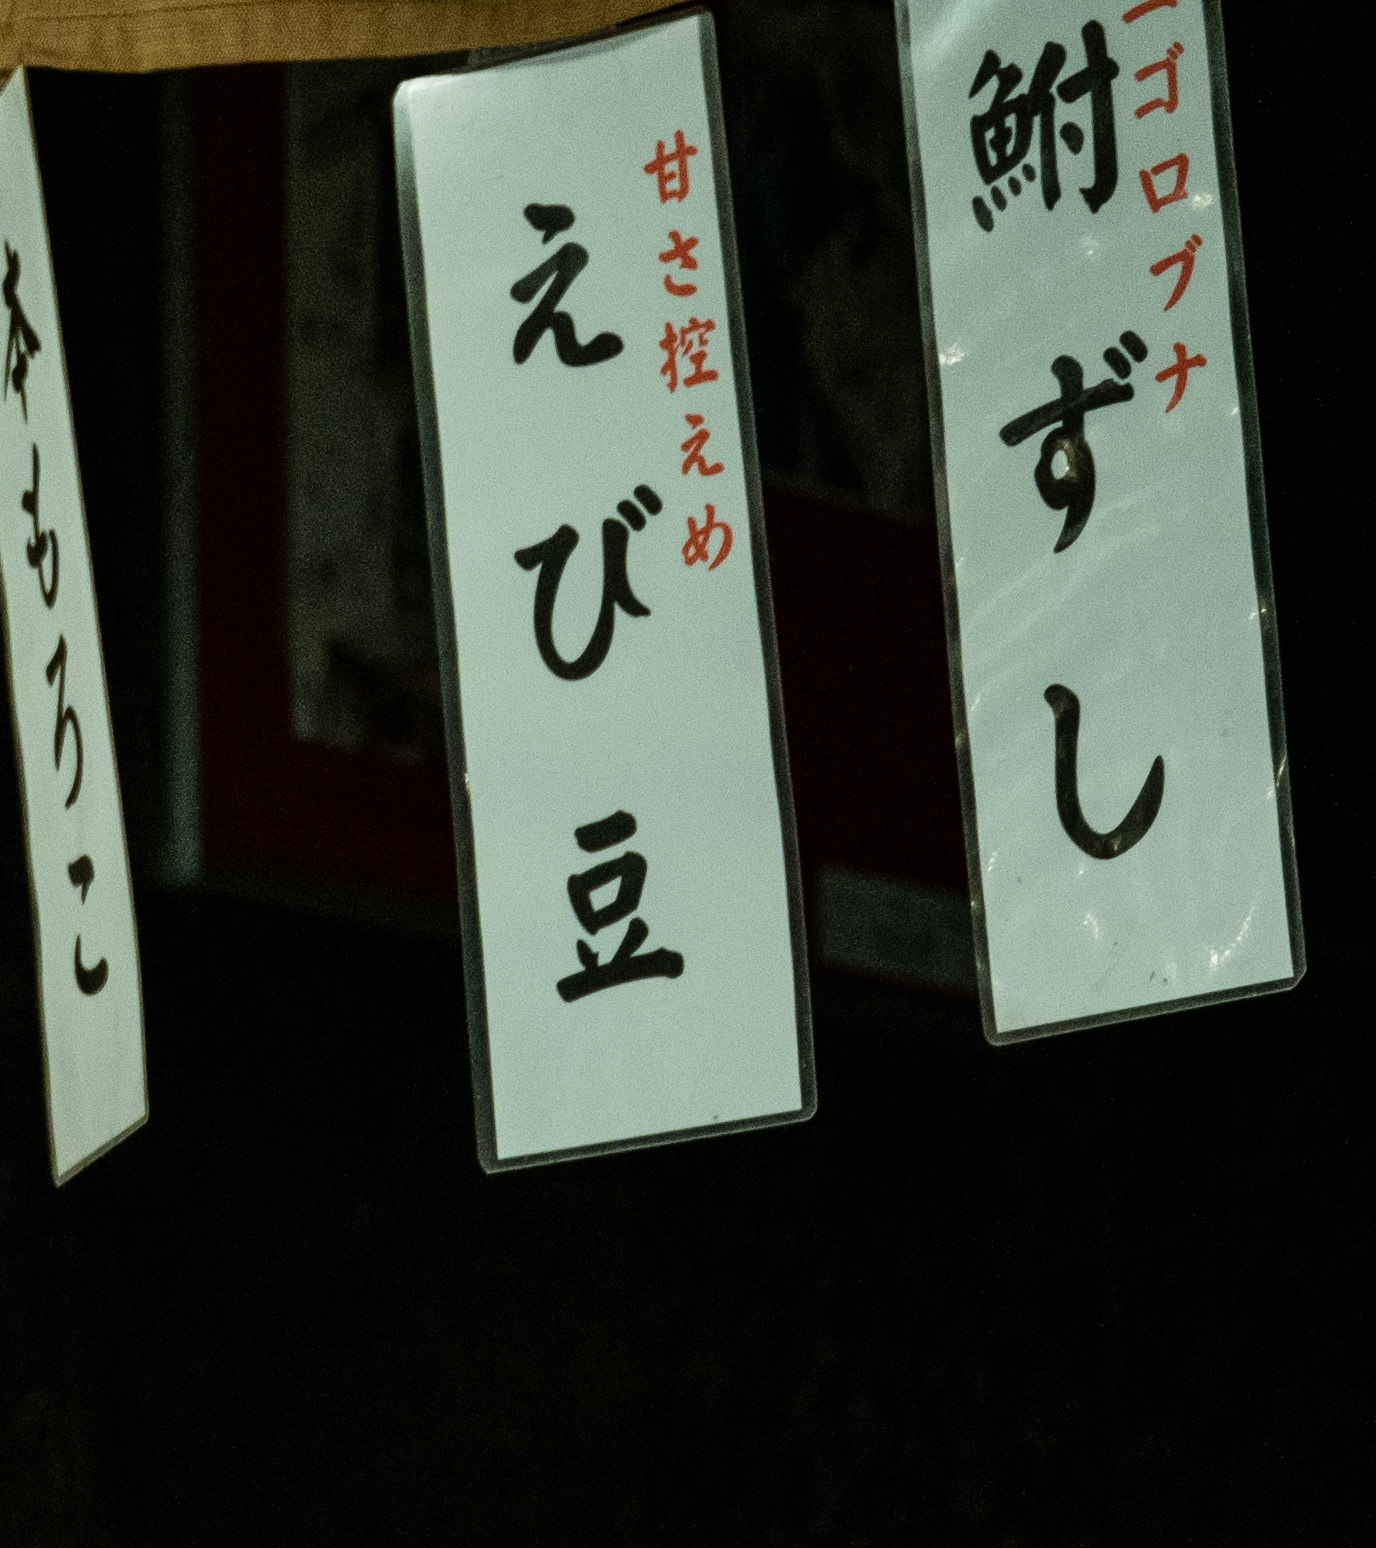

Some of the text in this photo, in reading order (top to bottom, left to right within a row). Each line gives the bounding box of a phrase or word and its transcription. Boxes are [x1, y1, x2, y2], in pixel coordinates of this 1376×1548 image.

[508, 202, 687, 1005] えび豆
[642, 128, 735, 573] 甘さ控えめ
[967, 18, 1166, 863] 鮒ずし
